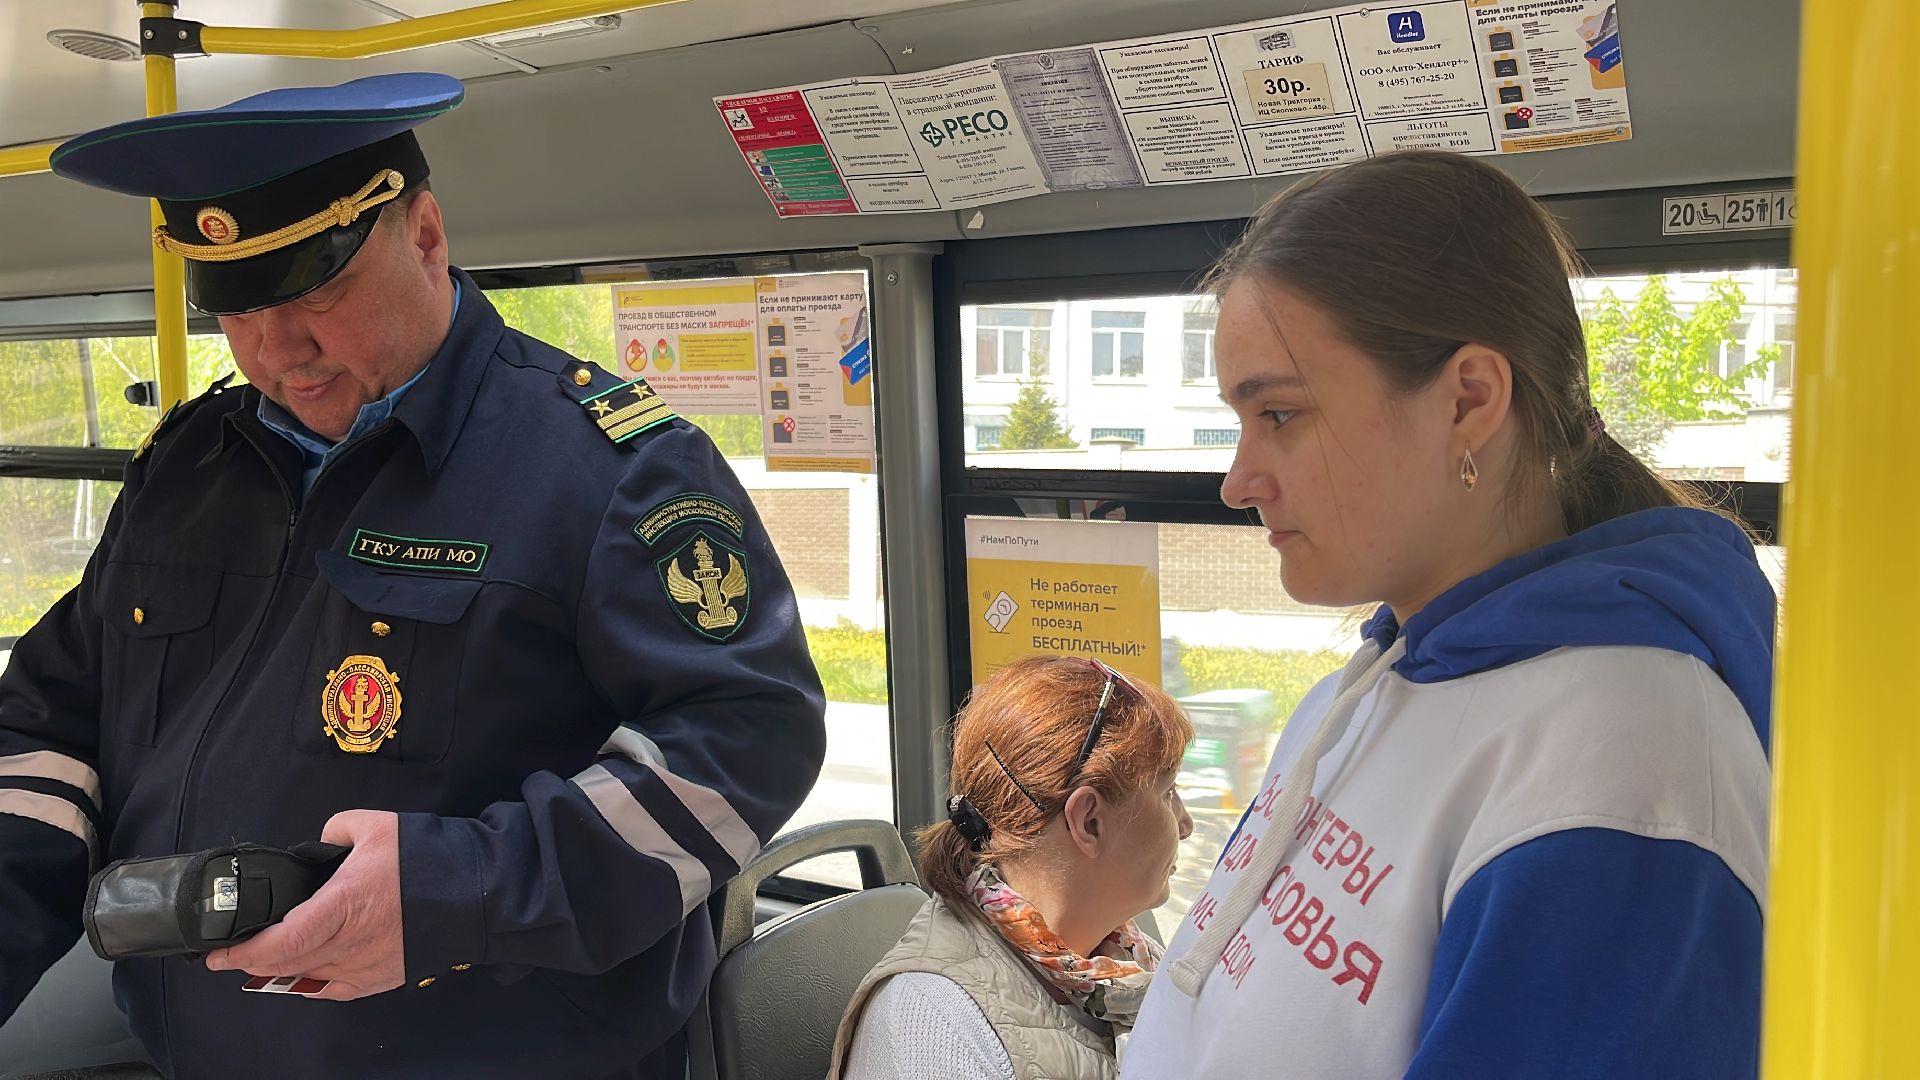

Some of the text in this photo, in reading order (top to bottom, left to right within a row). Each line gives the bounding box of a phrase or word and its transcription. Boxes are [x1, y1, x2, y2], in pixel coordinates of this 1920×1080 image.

[1476, 8, 1500, 17] Если
[1477, 4, 1584, 25] для оплаты проезда
[1119, 44, 1189, 57] Уважаемые пассажиры!
[1377, 43, 1442, 56] Вас обслуживает
[1124, 63, 1163, 73] обнаружении
[1163, 60, 1189, 68] забытых
[1257, 55, 1304, 70] ТАРИФ
[1129, 69, 1176, 79] подозрительных
[1359, 66, 1384, 77] ООО
[1163, 74, 1190, 83] автобуса
[1378, 72, 1455, 88] 8 (495) 767-25-20
[1135, 81, 1198, 93] убедительная просьба
[1186, 86, 1215, 94] водителю
[1263, 77, 1311, 96] 30р.
[897, 83, 997, 106] Пассажиры застрахованы
[912, 101, 953, 117] страховой
[954, 94, 998, 109] компании:
[1257, 97, 1321, 108] Новая Трехгорка
[1258, 108, 1270, 116] ИЦ
[941, 109, 1009, 140] РЕСО
[1159, 114, 1197, 123] ВЫПИСКА
[1259, 122, 1346, 138] Уважаемые пассажиры!
[1407, 121, 1449, 131] ЛЬГОТЫ
[951, 130, 1013, 146] ГАРАНТИЯ
[1392, 131, 1468, 142] предоставляются
[1287, 140, 1311, 149] просьба
[1449, 139, 1470, 147] ВОВ
[1328, 148, 1355, 157] требуйте
[1669, 203, 1695, 227] 20
[1726, 199, 1755, 224] 25
[760, 292, 864, 304] Если не принимают карту
[760, 303, 842, 314] для оплаты проезда
[618, 309, 717, 321] ПРОЕЗД В ОБЩЕСТВЕННОМ
[619, 322, 665, 332] ТРАНСПОРТЕ
[666, 322, 680, 330] БЕЗ
[681, 321, 707, 330] МАСКИ
[679, 375, 703, 383] поэтому
[703, 374, 726, 382] автобус
[639, 499, 742, 535] АДМИНИСТРАТИВНО-ПАССАЖИРСКАЯ
[644, 507, 741, 540] ИНСПЕКЦИЯ МОСКОВСКОЙ ОБЛАСТИ
[980, 535, 1039, 548] #НамПоПути
[359, 538, 477, 564] ГКУ АПИ МО
[696, 569, 720, 579] ЗАКОН
[1030, 578, 1118, 595] Не работает
[1030, 599, 1099, 613] терминал
[1032, 616, 1082, 632] проезд
